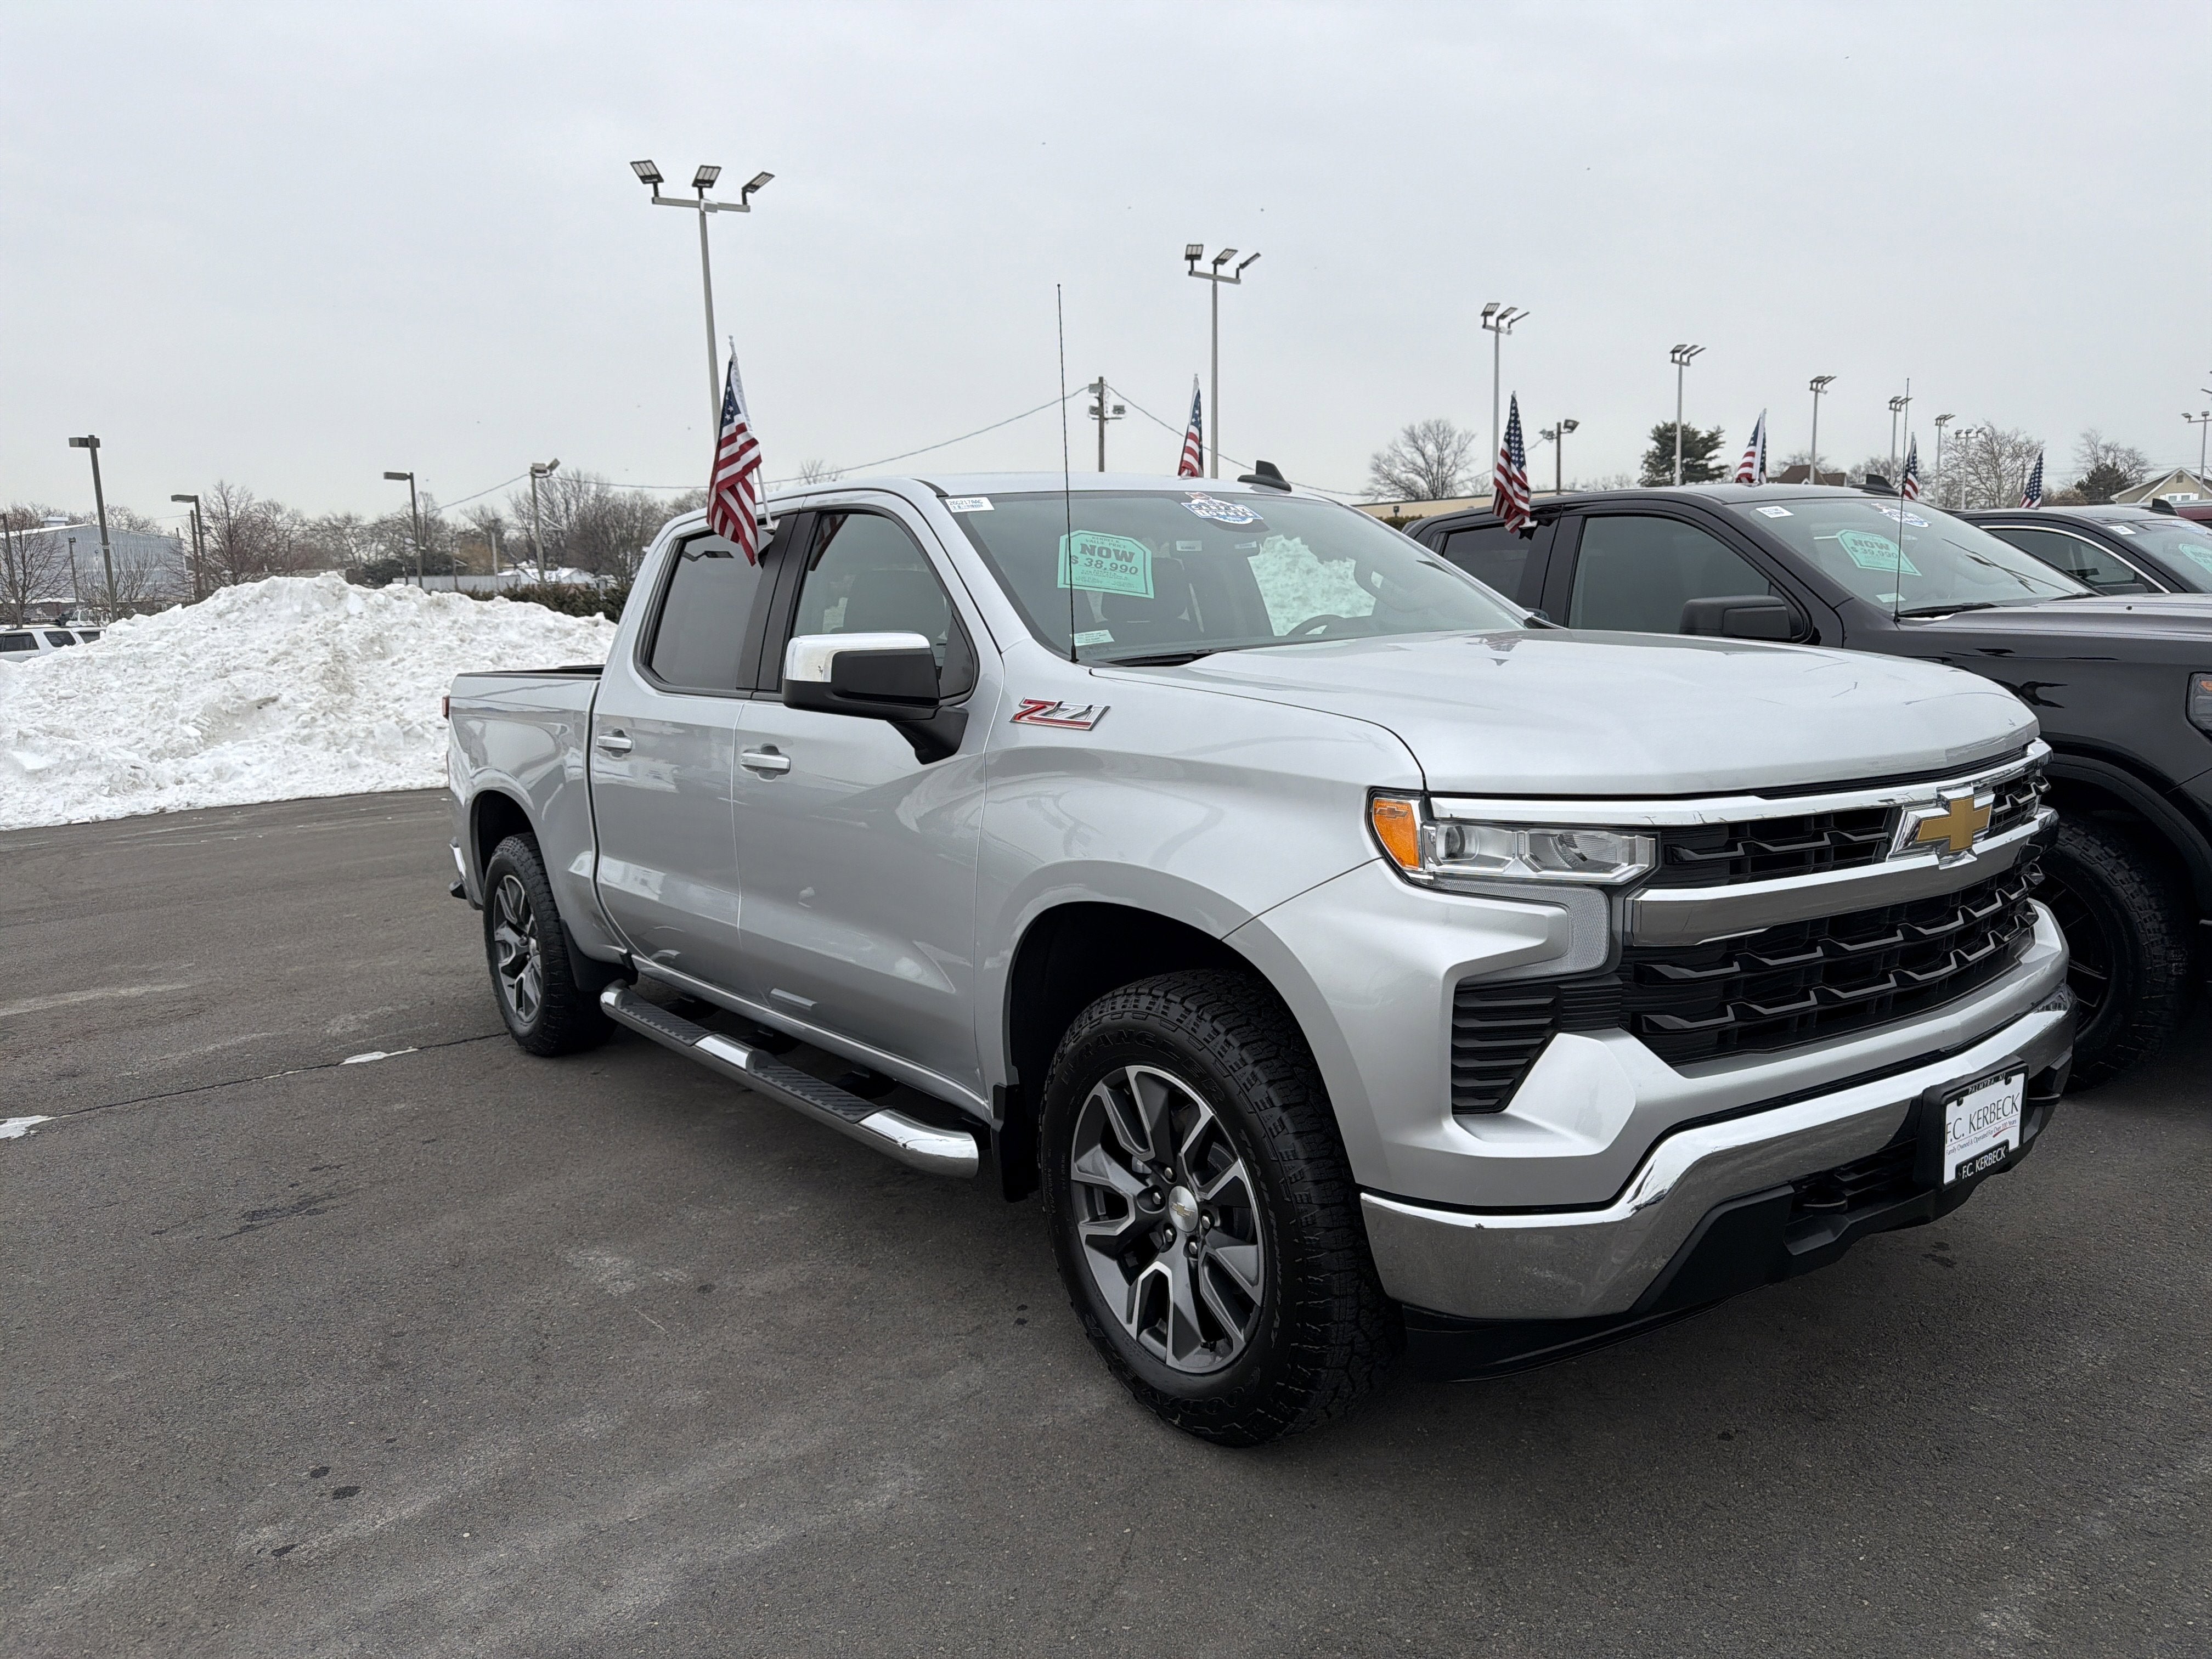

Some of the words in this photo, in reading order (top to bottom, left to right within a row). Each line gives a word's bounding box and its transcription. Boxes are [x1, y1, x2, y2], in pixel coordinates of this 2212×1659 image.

[1080, 543, 1135, 563] NOW
[1851, 539, 1891, 551] NOW
[1070, 555, 1079, 565] $
[1084, 558, 1138, 575] 38,990
[1008, 697, 1111, 732] Z71
[1968, 1078, 1995, 1094] PALMYRA
[1945, 1117, 1964, 1144] F.C.
[1969, 1092, 2020, 1134] KERBECK
[1946, 1146, 1957, 1156] Family
[1957, 1140, 1970, 1151] Owned
[1973, 1132, 1988, 1144] Operated
[1962, 1163, 1974, 1180] F.C.
[1975, 1145, 2006, 1173] KERBECK
